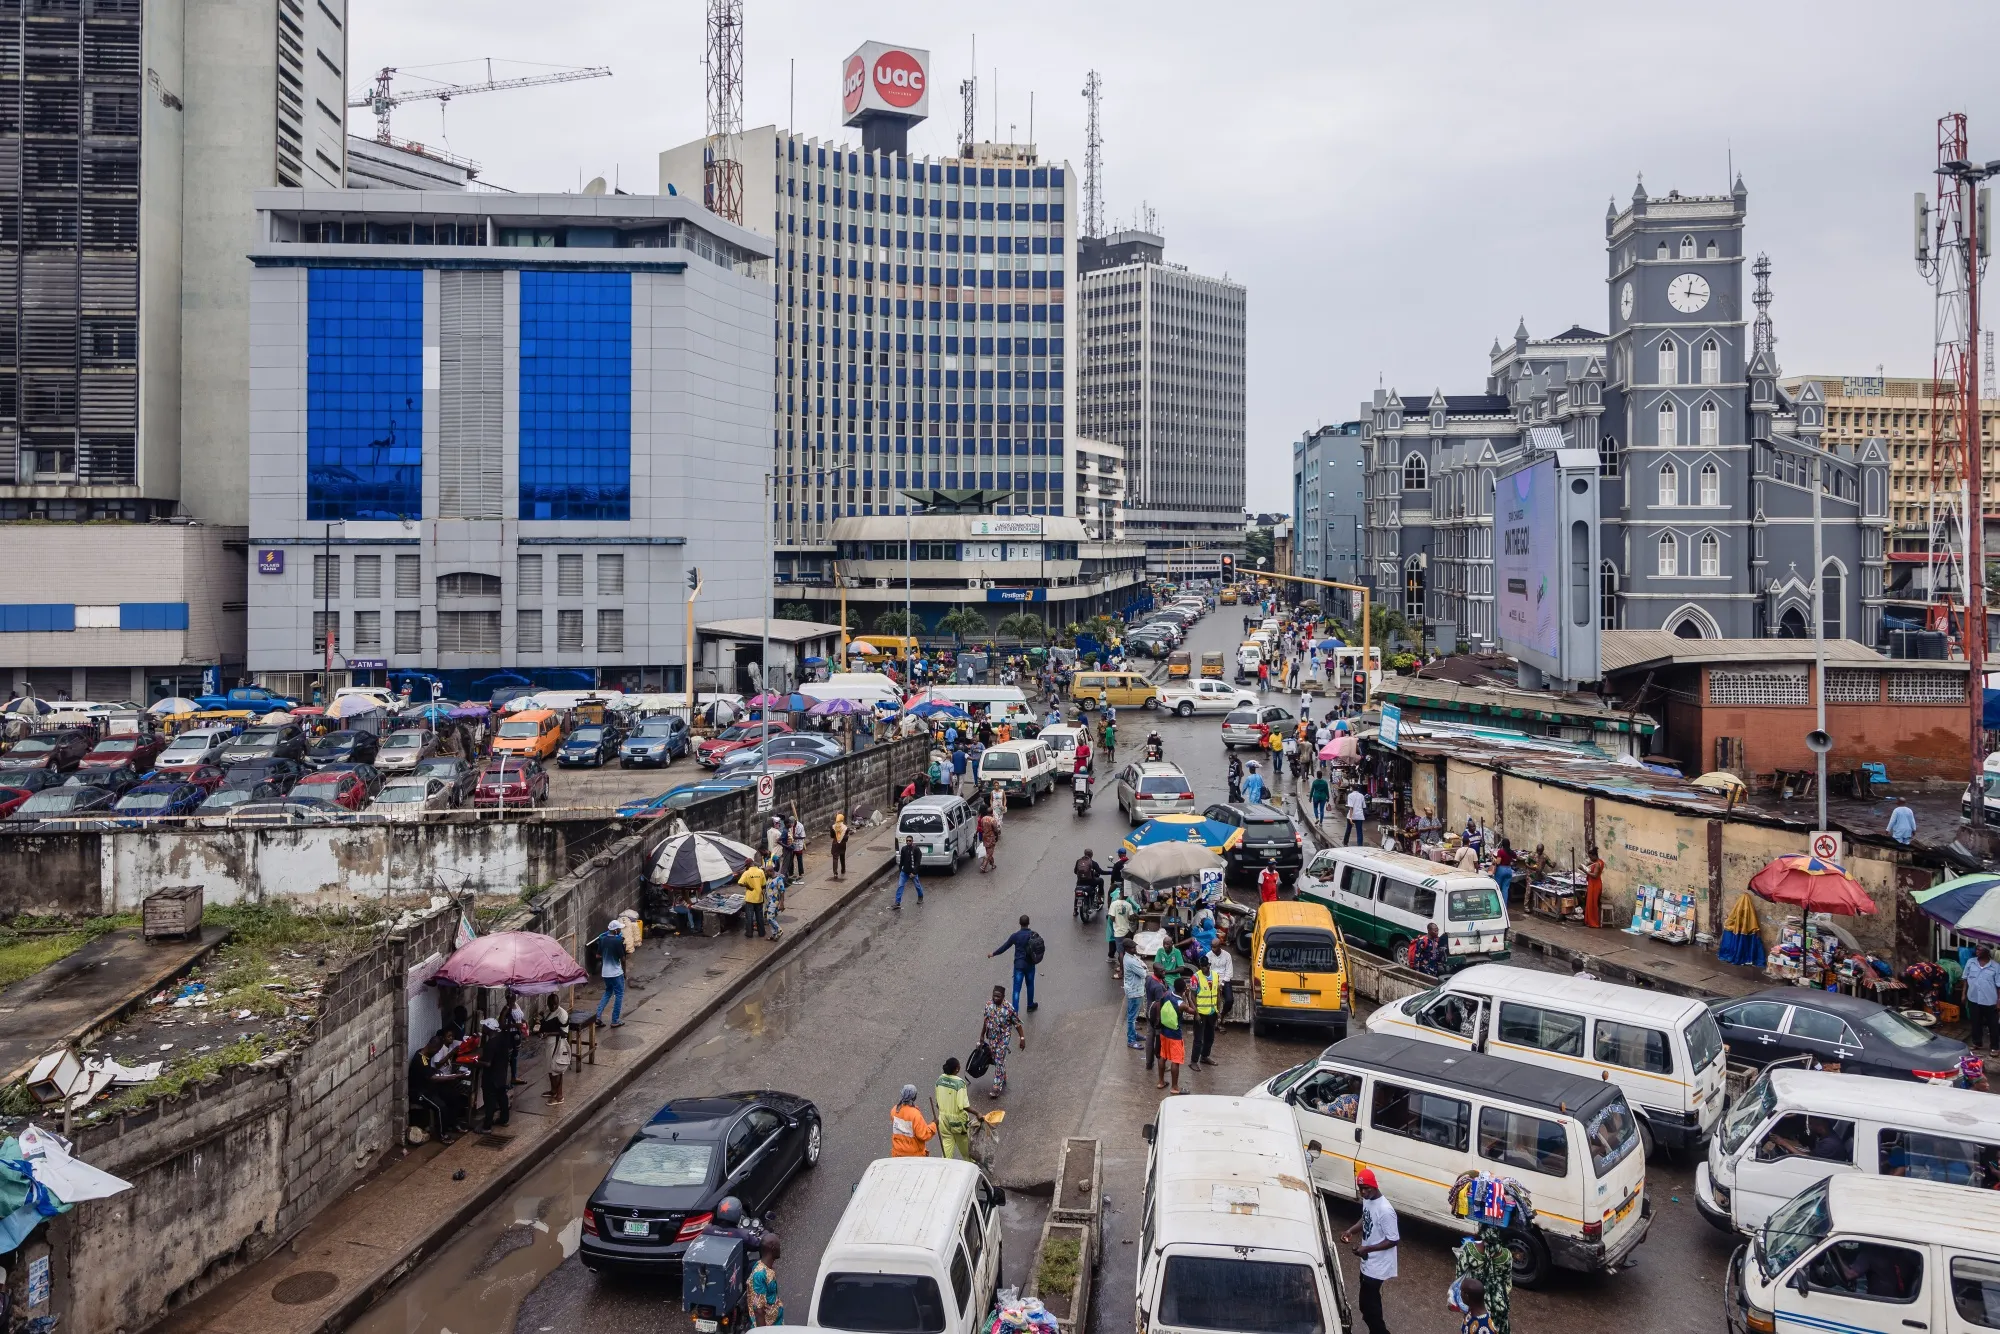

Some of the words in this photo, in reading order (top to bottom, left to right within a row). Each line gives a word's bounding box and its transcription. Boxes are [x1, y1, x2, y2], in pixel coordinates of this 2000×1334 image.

[877, 66, 922, 89] uac
[1842, 376, 1884, 387] CHURCH
[1845, 388, 1881, 396] HOUSE
[1625, 843, 1639, 851] KEEP
[1640, 847, 1658, 857] LAGOS
[1659, 852, 1678, 861] CLEAN
[1203, 871, 1223, 881] POS
